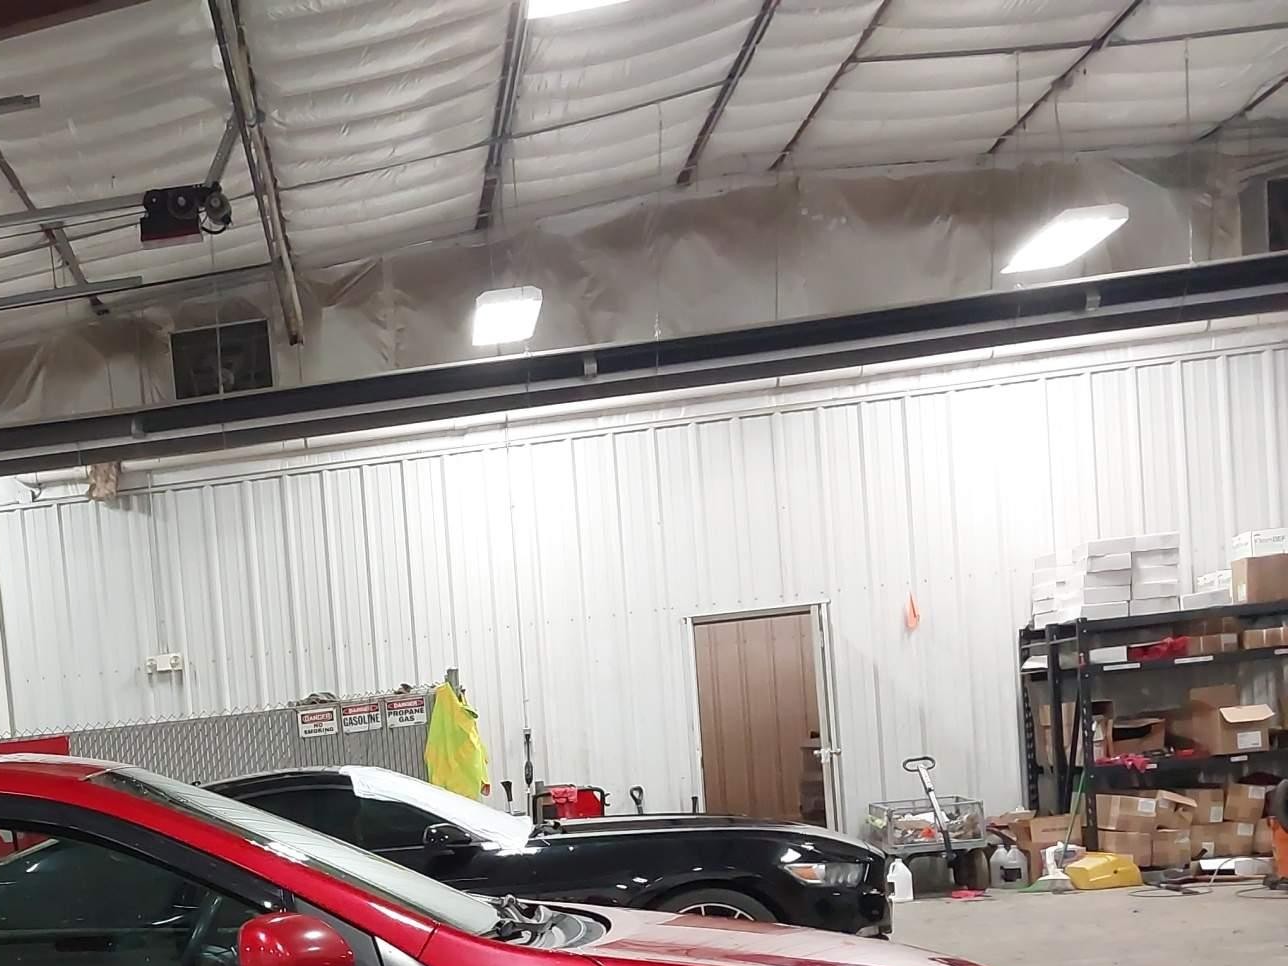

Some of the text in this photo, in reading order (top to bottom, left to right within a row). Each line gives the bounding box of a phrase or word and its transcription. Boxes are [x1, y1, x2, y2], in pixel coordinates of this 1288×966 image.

[393, 700, 418, 708] DANGER
[303, 712, 331, 722] DANGER
[387, 707, 425, 717] PROPANE
[343, 713, 380, 727] GASOLINE
[304, 727, 334, 735] SMOKING
